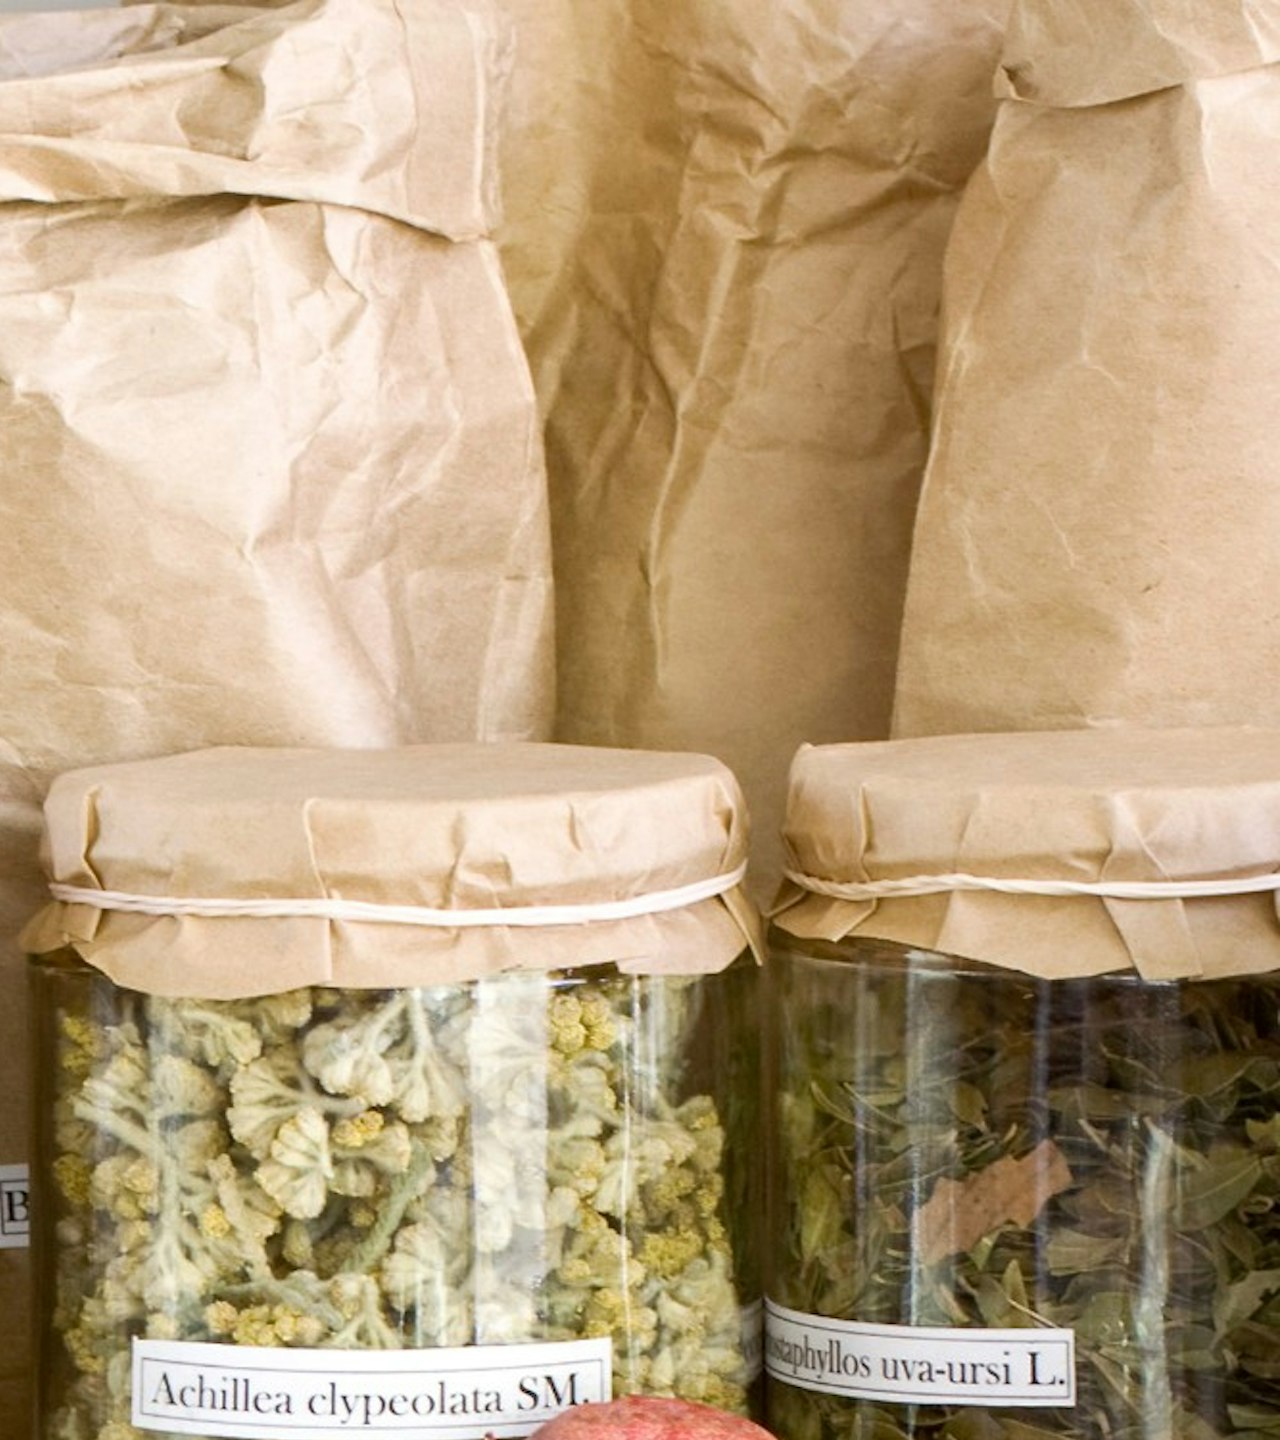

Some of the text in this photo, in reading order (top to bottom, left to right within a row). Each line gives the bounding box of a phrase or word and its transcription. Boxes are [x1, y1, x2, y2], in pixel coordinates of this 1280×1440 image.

[881, 1351, 1011, 1385] uva-ursi
[1027, 1351, 1065, 1385] L.
[152, 1372, 589, 1424] Achillea clypeolata SM.
